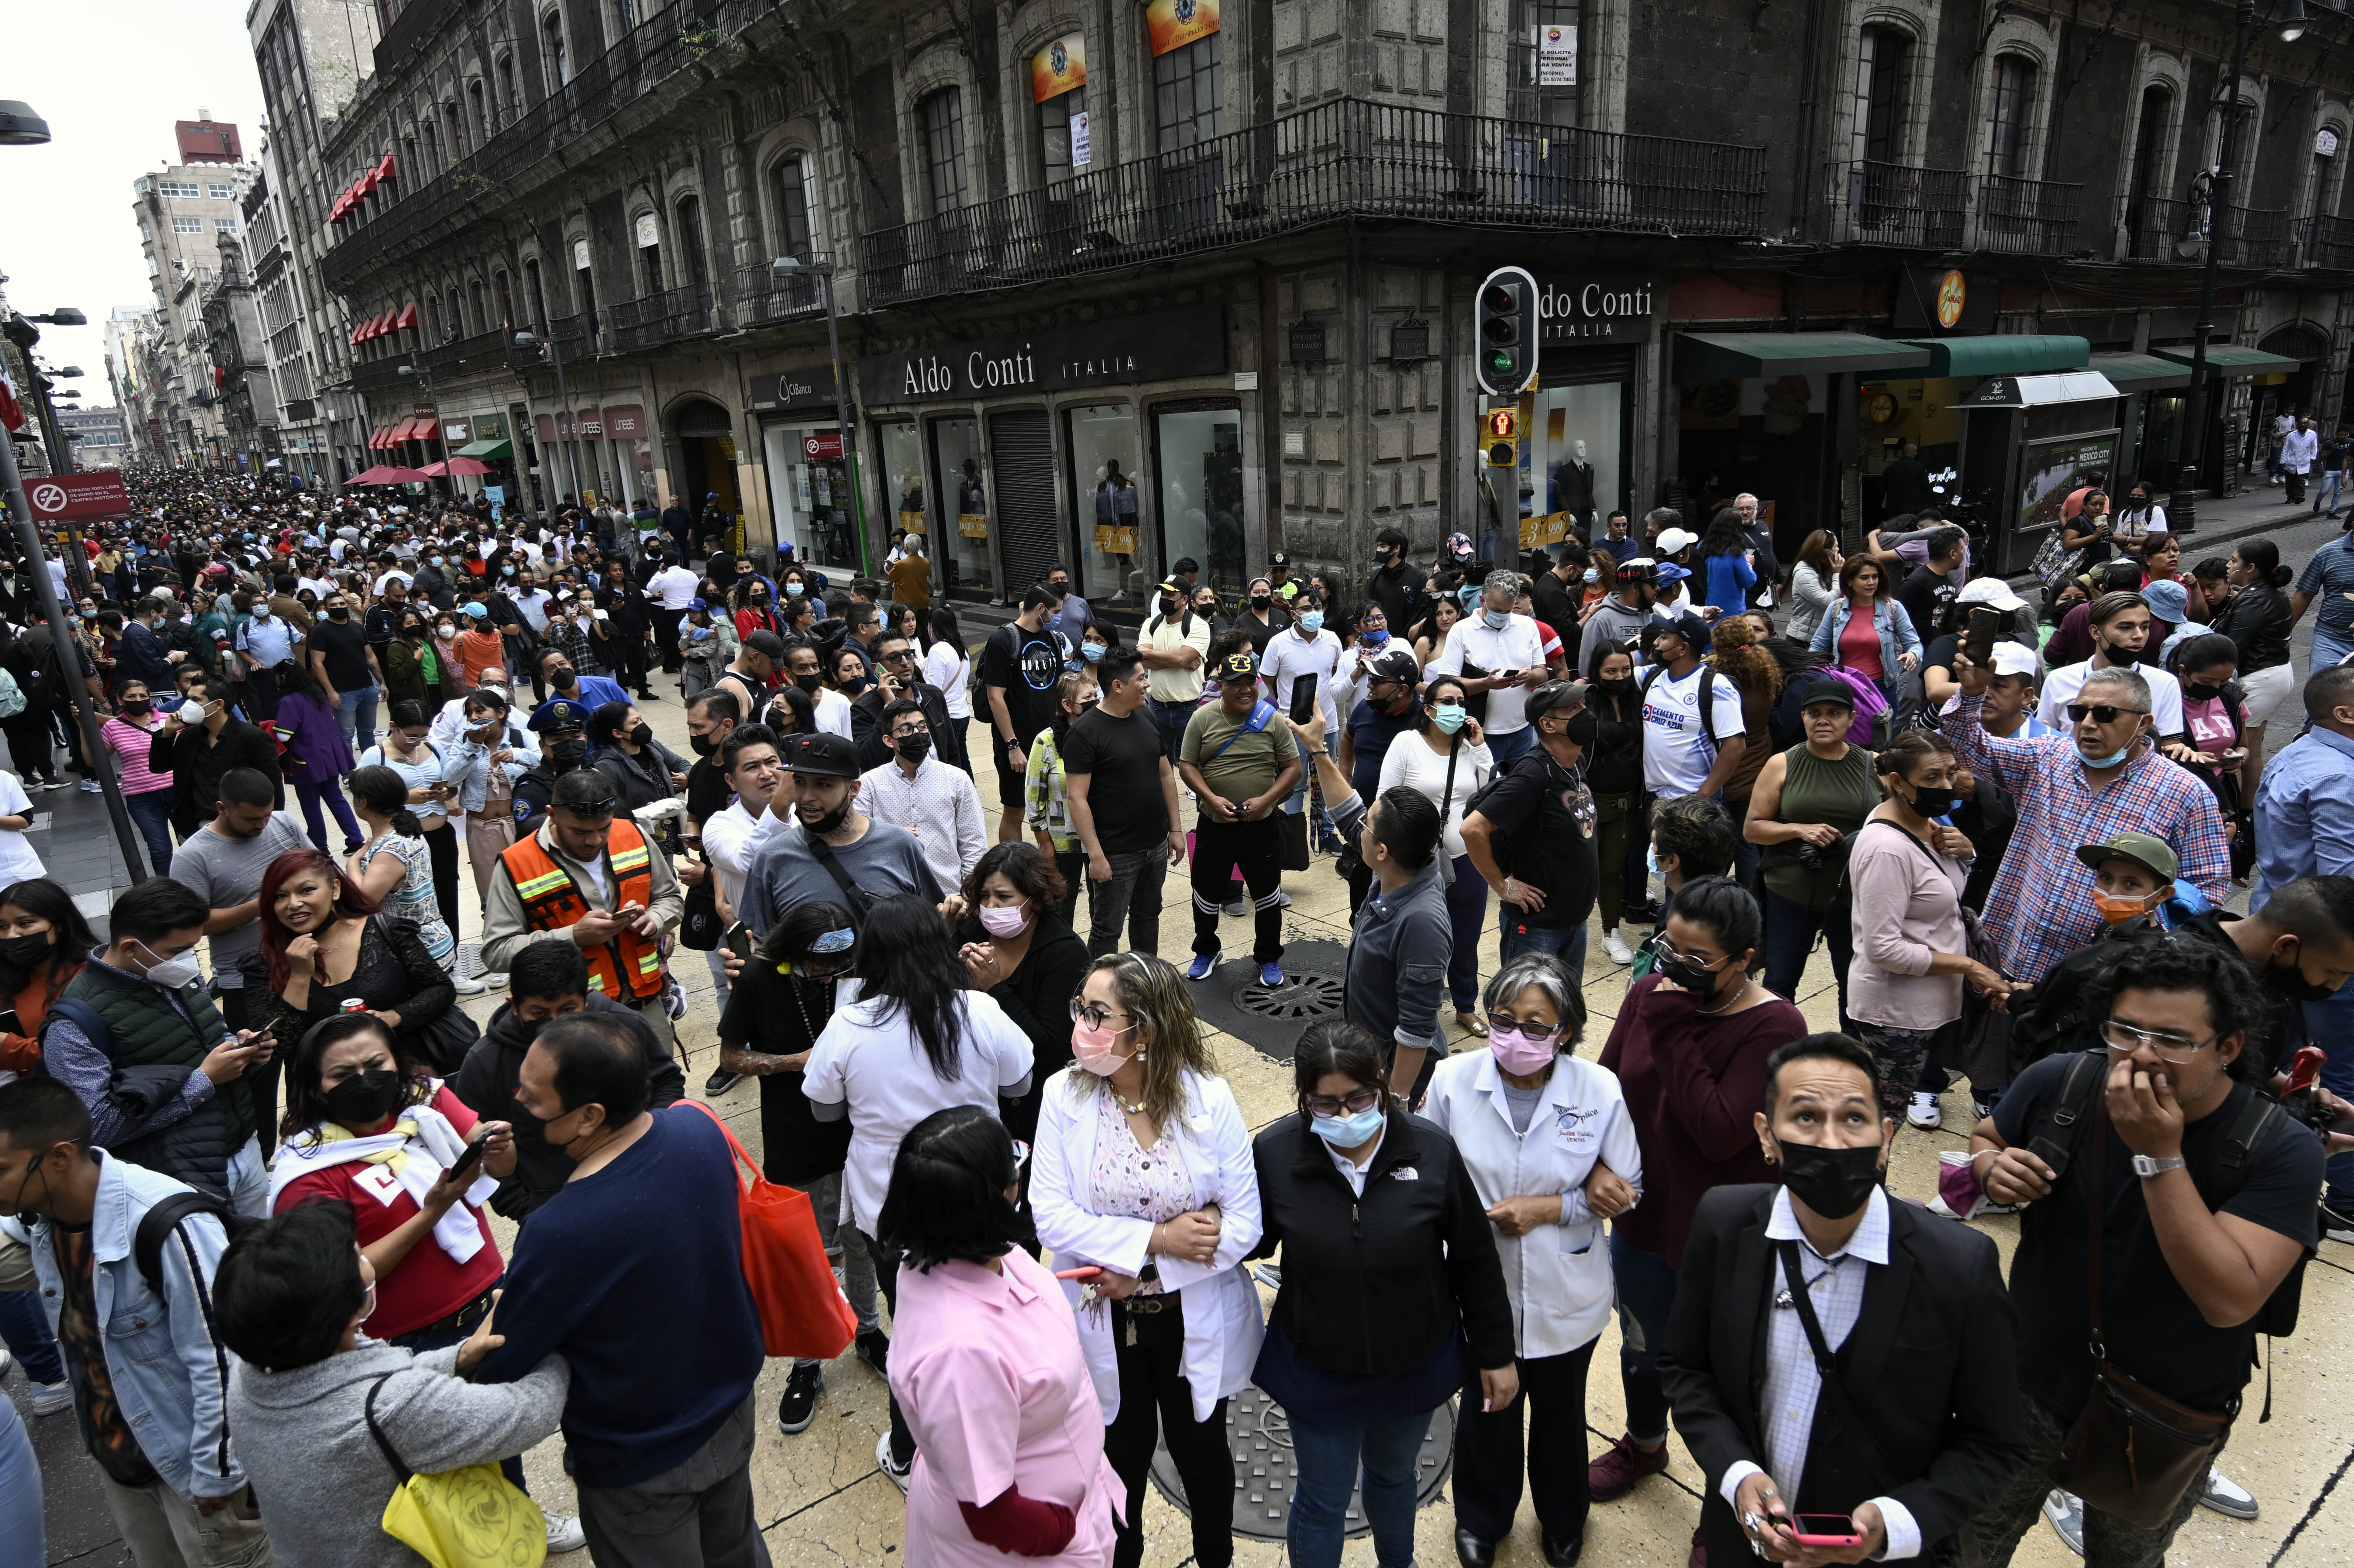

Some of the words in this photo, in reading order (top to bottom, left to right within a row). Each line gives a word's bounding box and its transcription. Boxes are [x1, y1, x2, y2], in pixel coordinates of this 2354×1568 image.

[1540, 284, 1571, 318] do
[1582, 282, 1652, 317] Conti
[1547, 323, 1611, 338] ITALIA
[904, 356, 951, 394] Aldo
[968, 343, 1035, 389] Conti
[1063, 356, 1134, 378] ITALIA
[789, 384, 812, 396] CIBanco
[2079, 452, 2098, 462] MEXICO
[2099, 450, 2110, 459] CITY
[1104, 530, 1112, 548] 3
[1528, 523, 1538, 543] 3
[1934, 585, 1946, 595] HOLD
[1652, 707, 1684, 722] CEMENTO
[1651, 715, 1665, 726] CRUZ
[1666, 720, 1683, 730] AZUL
[800, 741, 830, 757] FILA
[1558, 1104, 1578, 1117] Mundo
